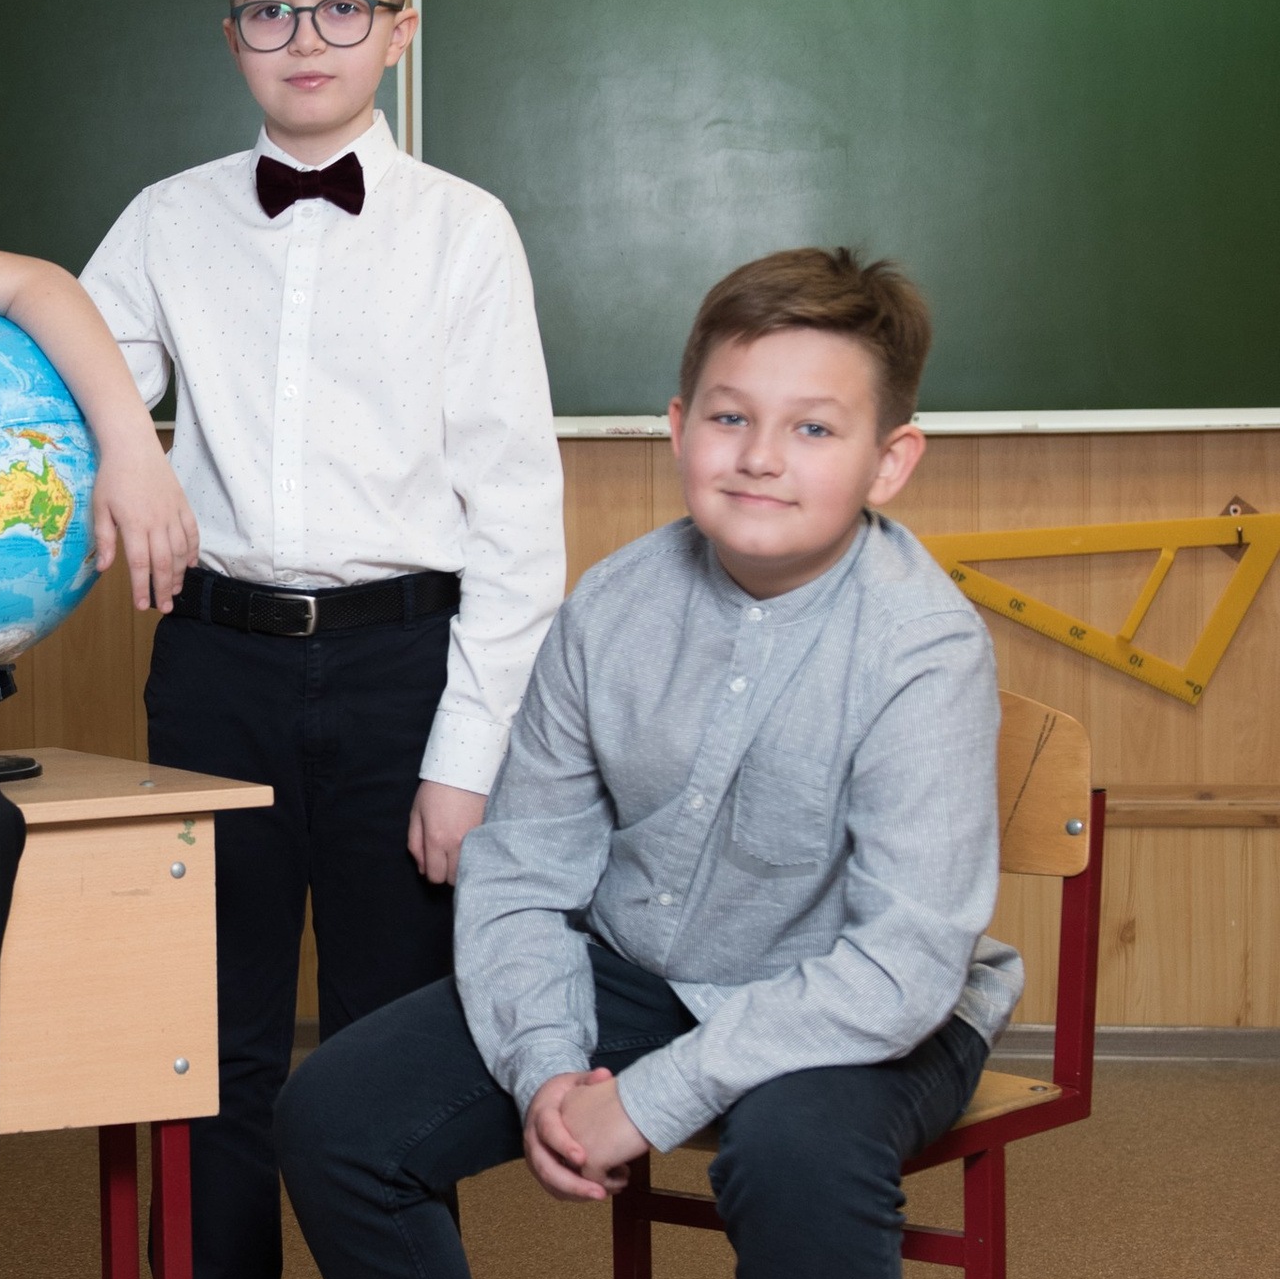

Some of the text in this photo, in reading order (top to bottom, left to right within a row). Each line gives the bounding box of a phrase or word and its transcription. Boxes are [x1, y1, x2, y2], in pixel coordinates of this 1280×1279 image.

[950, 568, 967, 583] 40
[1009, 597, 1027, 613] 30
[1069, 625, 1087, 640] 20
[1129, 654, 1144, 668] 10
